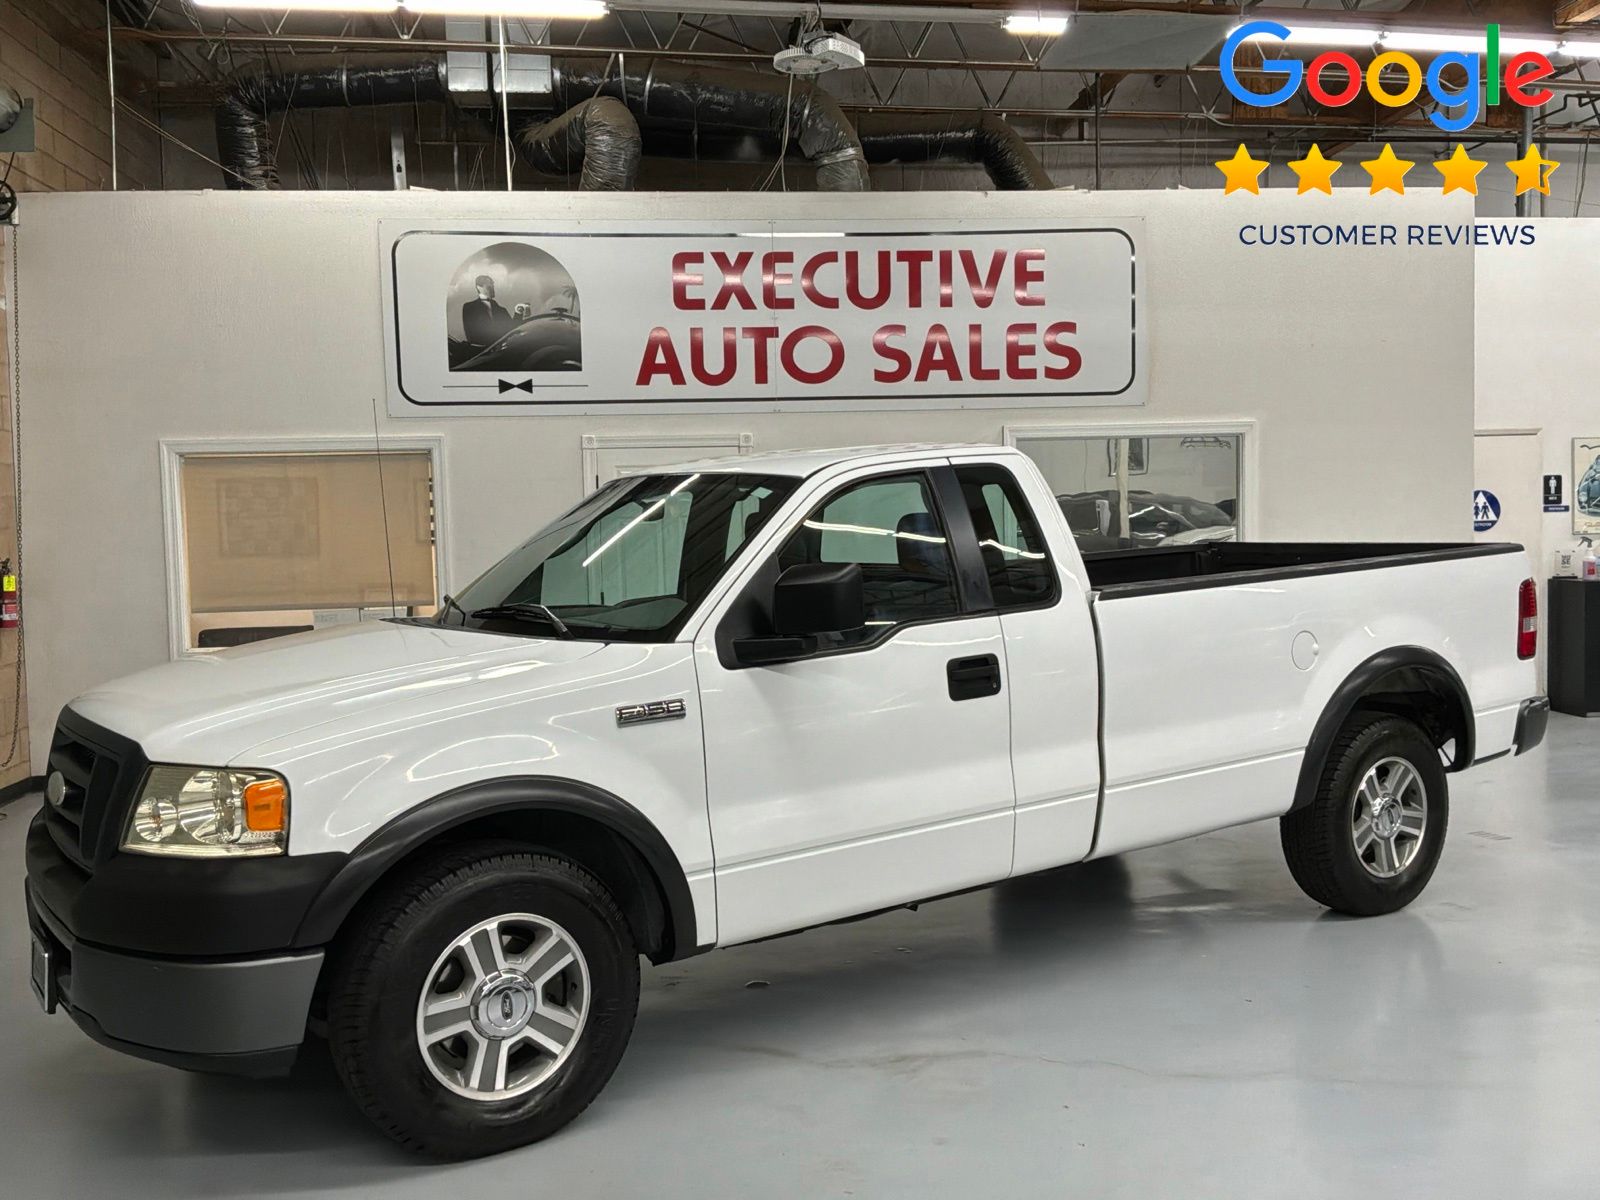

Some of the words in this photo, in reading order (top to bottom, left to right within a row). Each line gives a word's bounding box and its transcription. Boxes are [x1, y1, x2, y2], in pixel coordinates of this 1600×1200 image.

[671, 248, 1047, 311] EXECUTIVE
[636, 324, 846, 387] AUTO
[873, 322, 1082, 384] SALES
